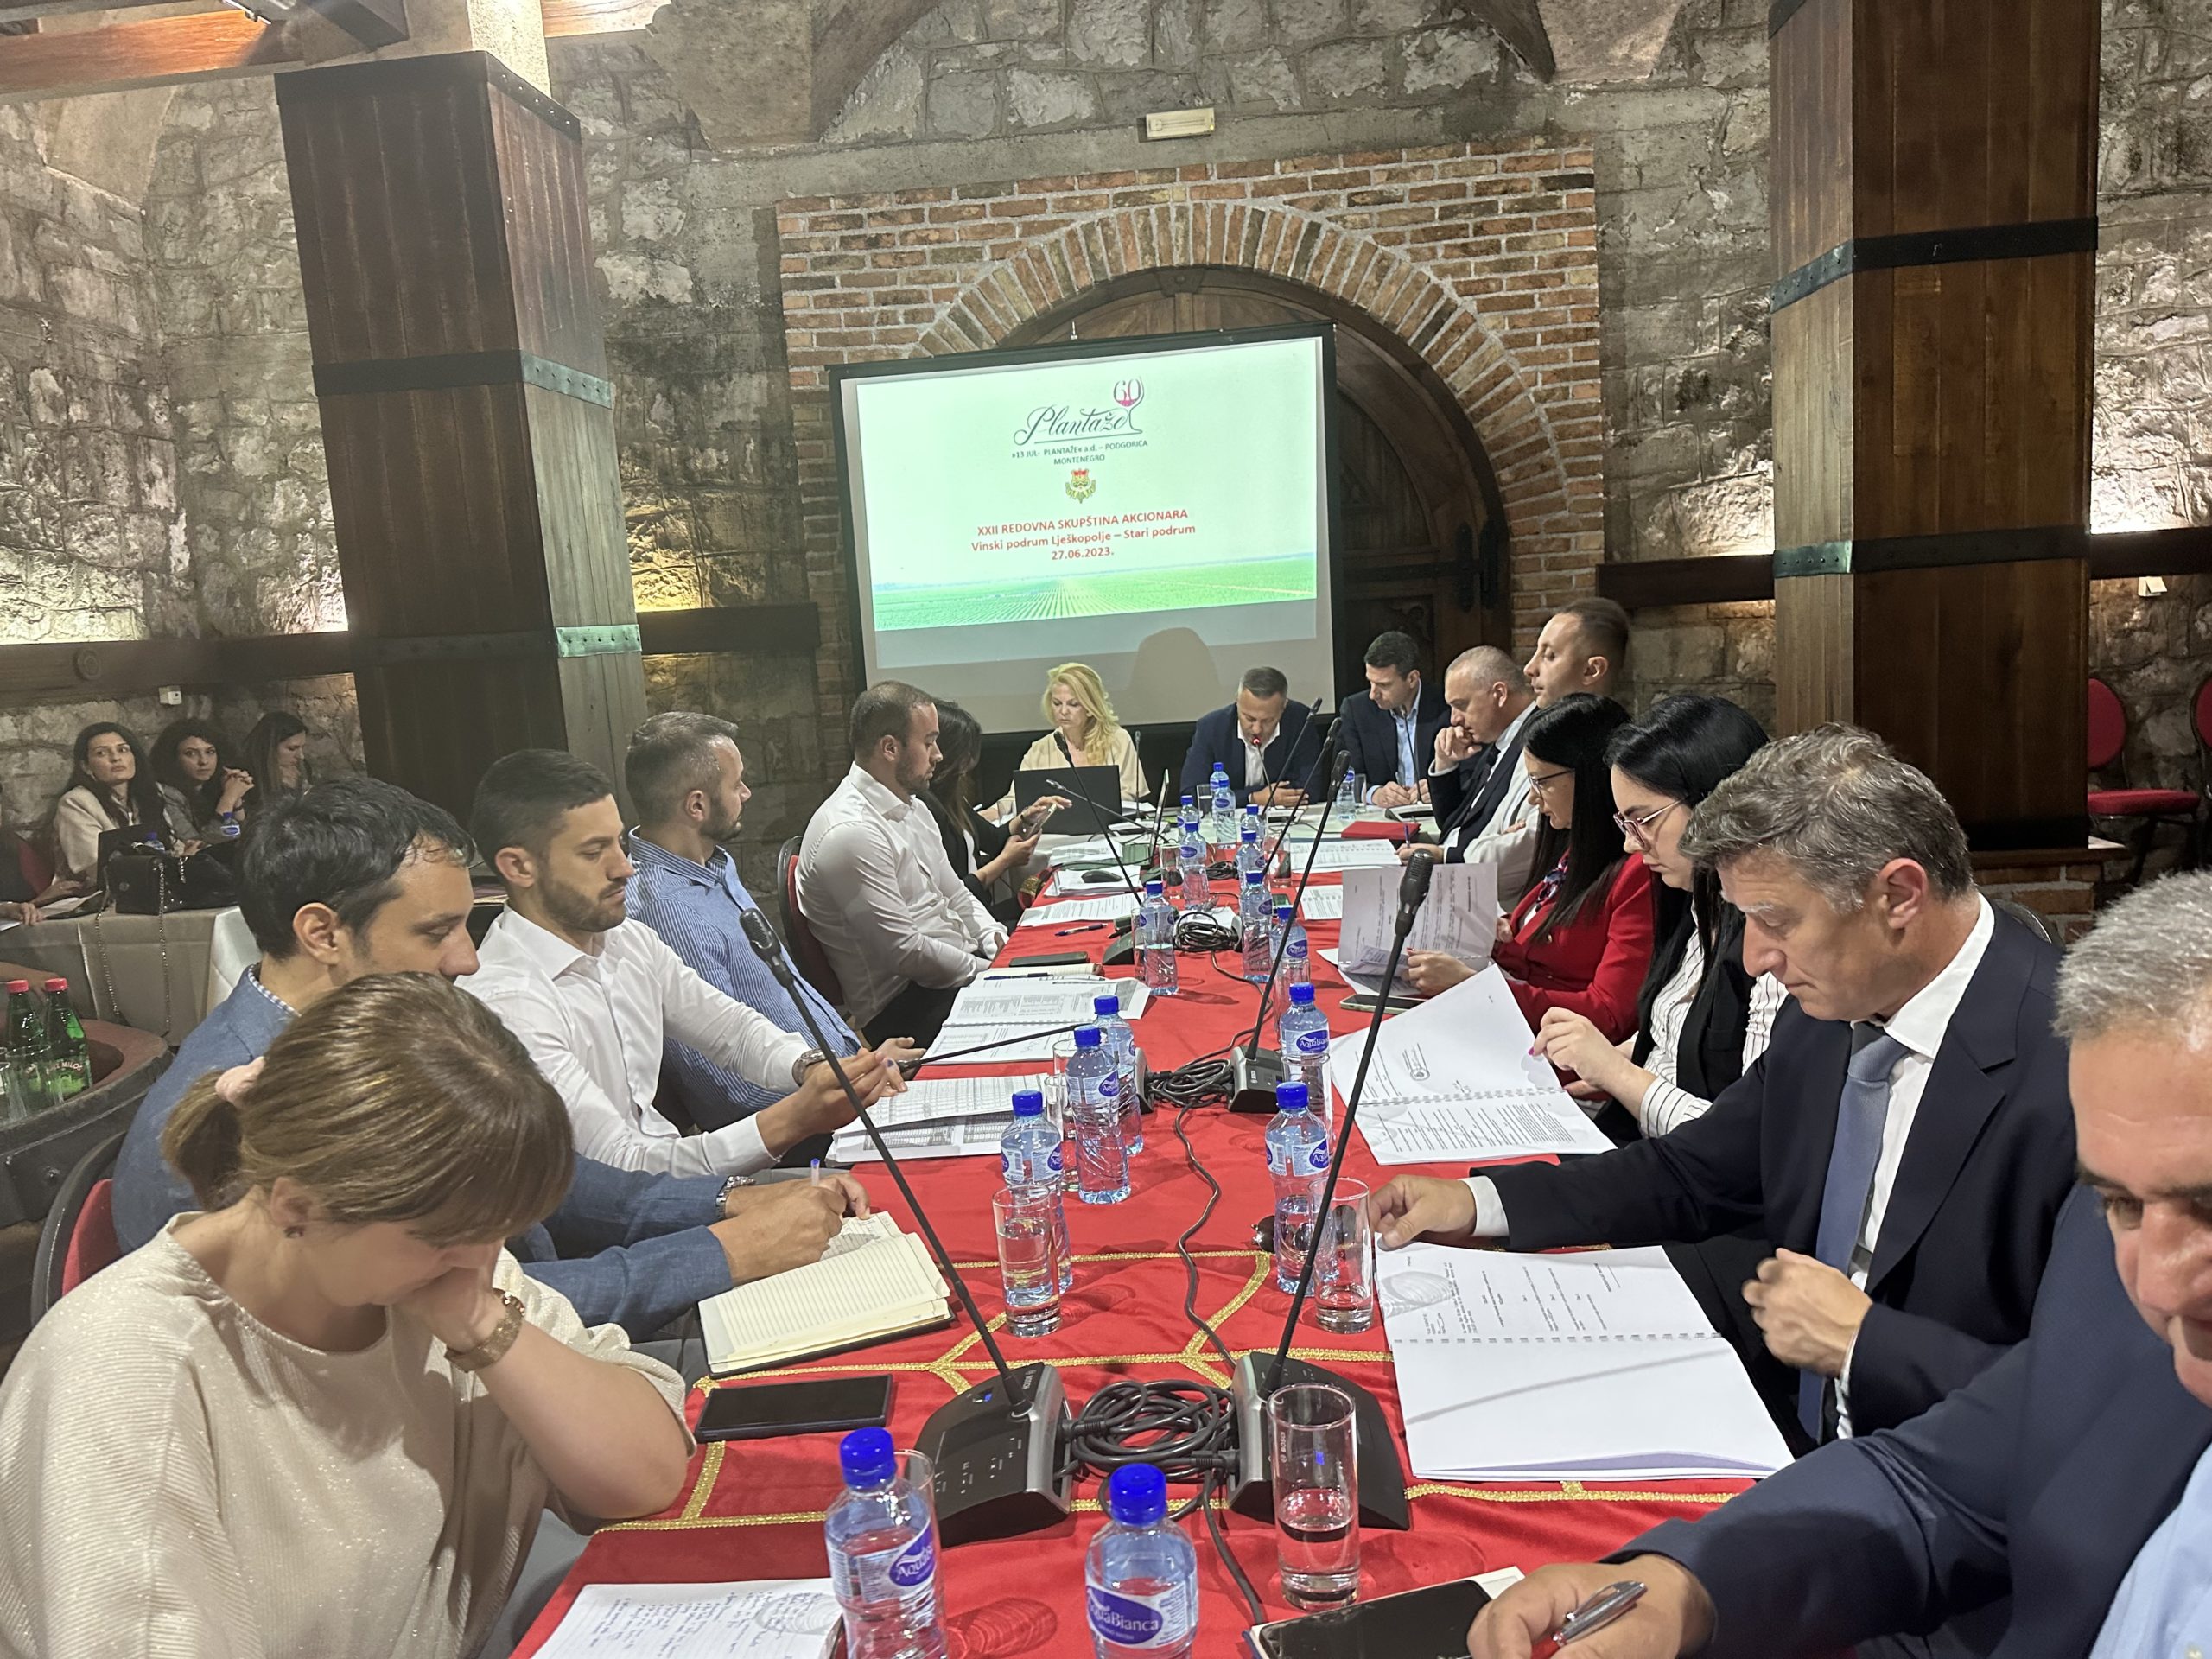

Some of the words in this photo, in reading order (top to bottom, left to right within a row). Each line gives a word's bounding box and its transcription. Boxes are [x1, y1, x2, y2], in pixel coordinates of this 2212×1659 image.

[1014, 404, 1129, 446] Plantaže
[1105, 440, 1148, 450] PODGORICA
[1053, 454, 1105, 465] MONTENEGRO
[977, 525, 998, 536] XXII
[1001, 521, 1056, 534] REDOVNA
[1058, 515, 1119, 530] SKUPŠTINA
[1122, 509, 1188, 524] AKCIONARA
[971, 539, 1003, 551] Vinski
[1007, 537, 1049, 551] podrum
[1052, 531, 1111, 547] Lješkopolje
[1123, 527, 1149, 539] Stari
[1152, 525, 1196, 539] podrum
[1051, 546, 1115, 561] 27.06.2023.
